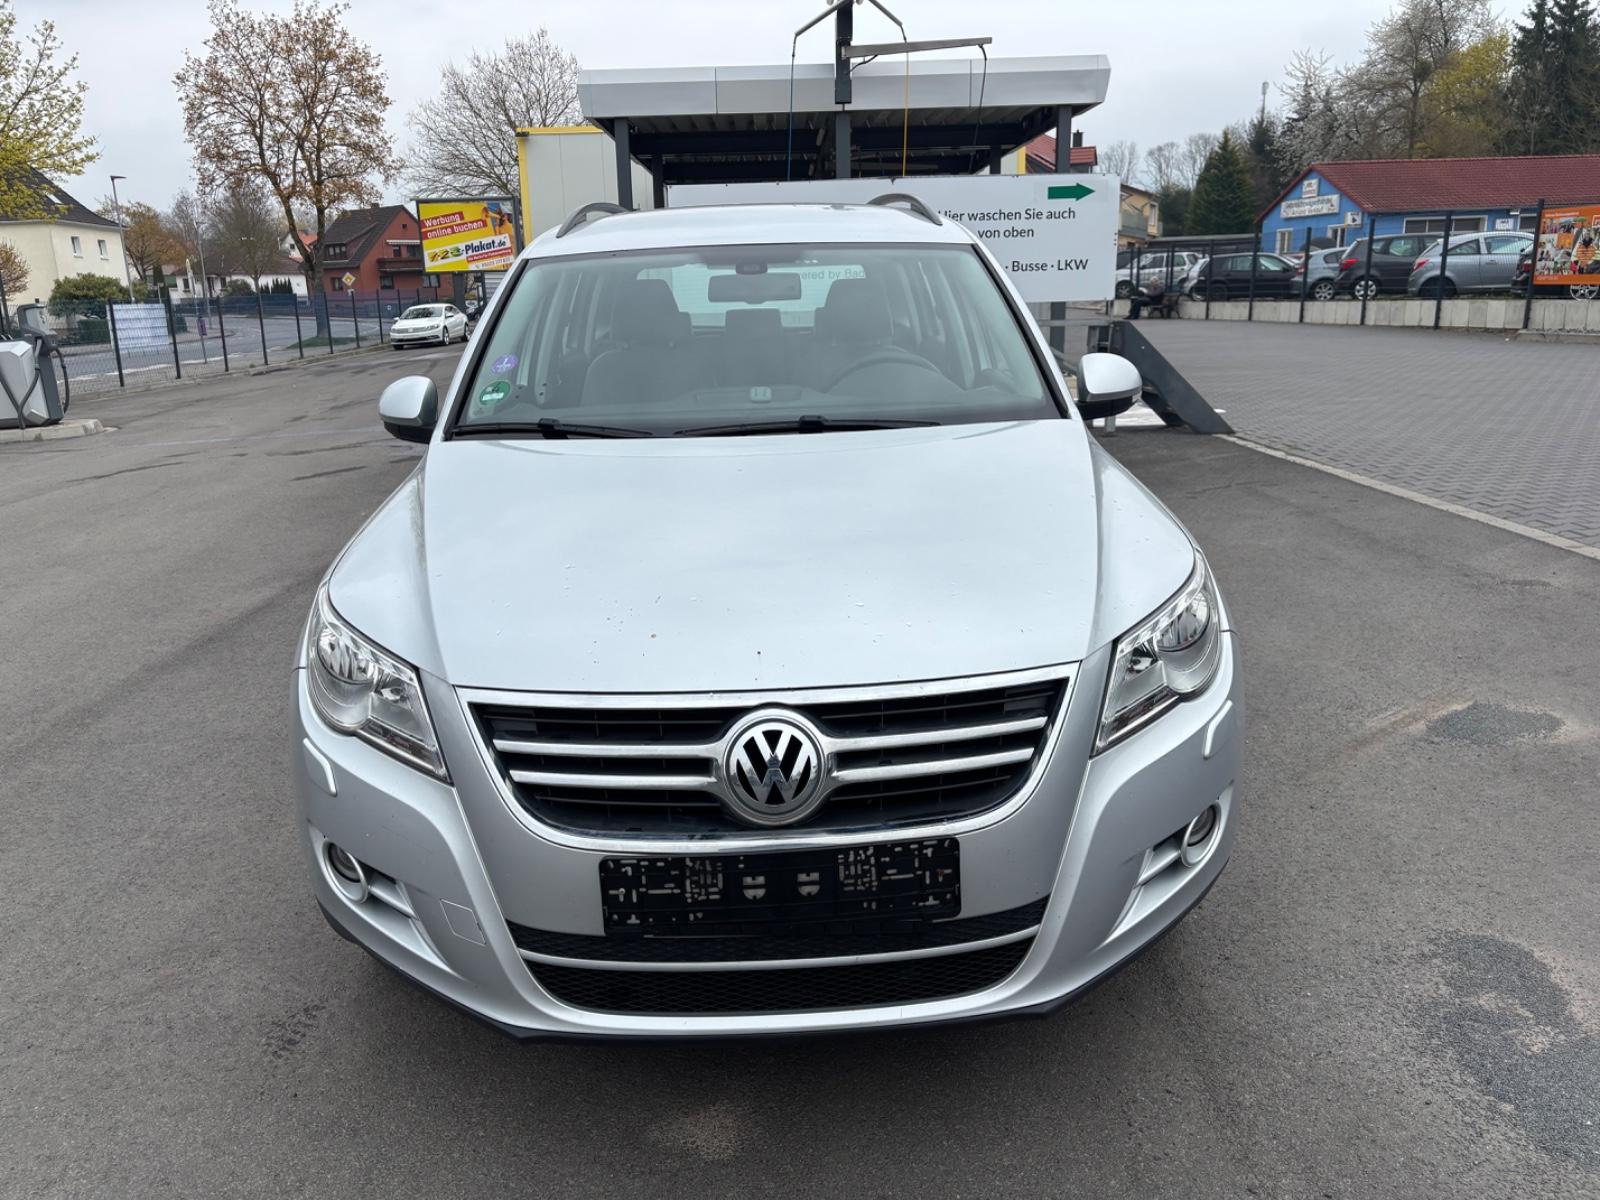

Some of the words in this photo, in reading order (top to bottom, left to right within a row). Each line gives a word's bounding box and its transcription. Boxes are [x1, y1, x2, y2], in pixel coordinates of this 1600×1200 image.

[424, 213, 460, 227] Werbung
[967, 209, 1022, 221] waschen
[1024, 208, 1043, 220] Sie
[1046, 207, 1076, 220] auch
[427, 227, 452, 239] online
[453, 221, 483, 233] buchen
[977, 229, 1001, 239] von
[1003, 226, 1034, 238] oben
[1011, 260, 1048, 272] Busse
[1057, 258, 1089, 271] LKW
